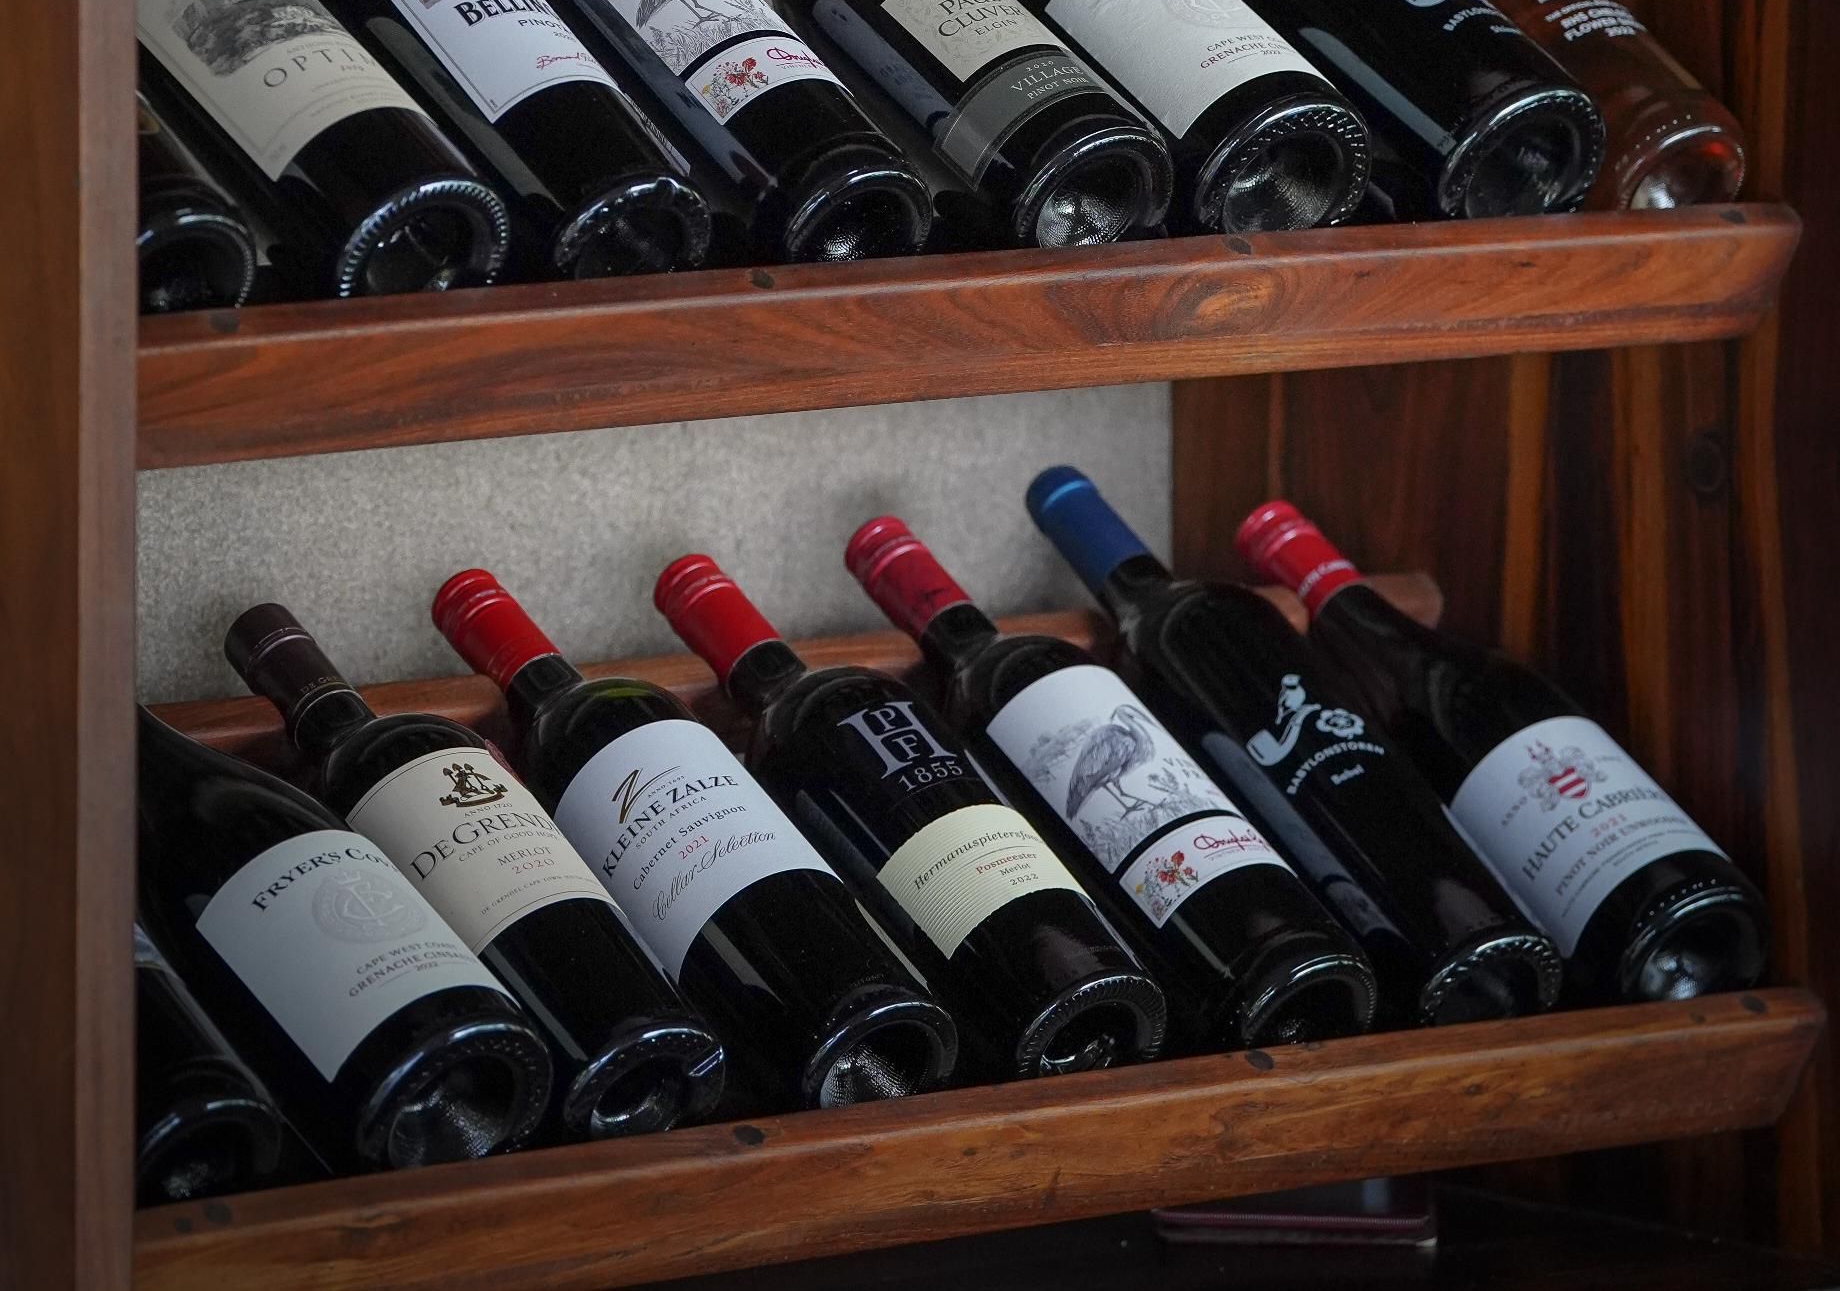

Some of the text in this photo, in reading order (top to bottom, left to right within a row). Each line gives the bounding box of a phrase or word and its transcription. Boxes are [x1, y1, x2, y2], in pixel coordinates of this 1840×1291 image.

[938, 5, 1028, 37] CLUVER
[974, 19, 1017, 36] ELGIN
[1200, 42, 1267, 69] GRENACHE
[1207, 37, 1235, 52] CAPE
[1235, 34, 1265, 42] WEST
[1010, 66, 1083, 91] VILLAGE
[1026, 60, 1054, 72] 2020
[1027, 77, 1089, 99] PINOT NOIR
[899, 761, 962, 791] 1855
[1286, 740, 1385, 795] BABYLONSTOREN
[464, 805, 491, 818] ANNO
[602, 775, 739, 878] KLEINE ZALZE
[635, 795, 707, 849] SOUTH AFRICA
[458, 843, 484, 862] CAPE
[487, 835, 501, 846] OF
[503, 830, 534, 840] GOOD
[497, 846, 552, 866] MERLOT
[633, 804, 746, 890] Cabernet Sauvignon
[679, 835, 710, 860] 2021
[1522, 815, 1580, 881] HAUTE
[511, 858, 555, 875] 2020
[652, 831, 775, 920] Cellar Selection
[1000, 863, 1031, 876] Merlot
[1009, 873, 1039, 886] 2022
[1555, 858, 1586, 896] PINOT
[1585, 833, 1619, 857] NOIR
[252, 852, 341, 912] FRYER'S
[356, 954, 386, 975] CAPE
[388, 943, 422, 957] WEST
[349, 954, 421, 998] GRENACHE
